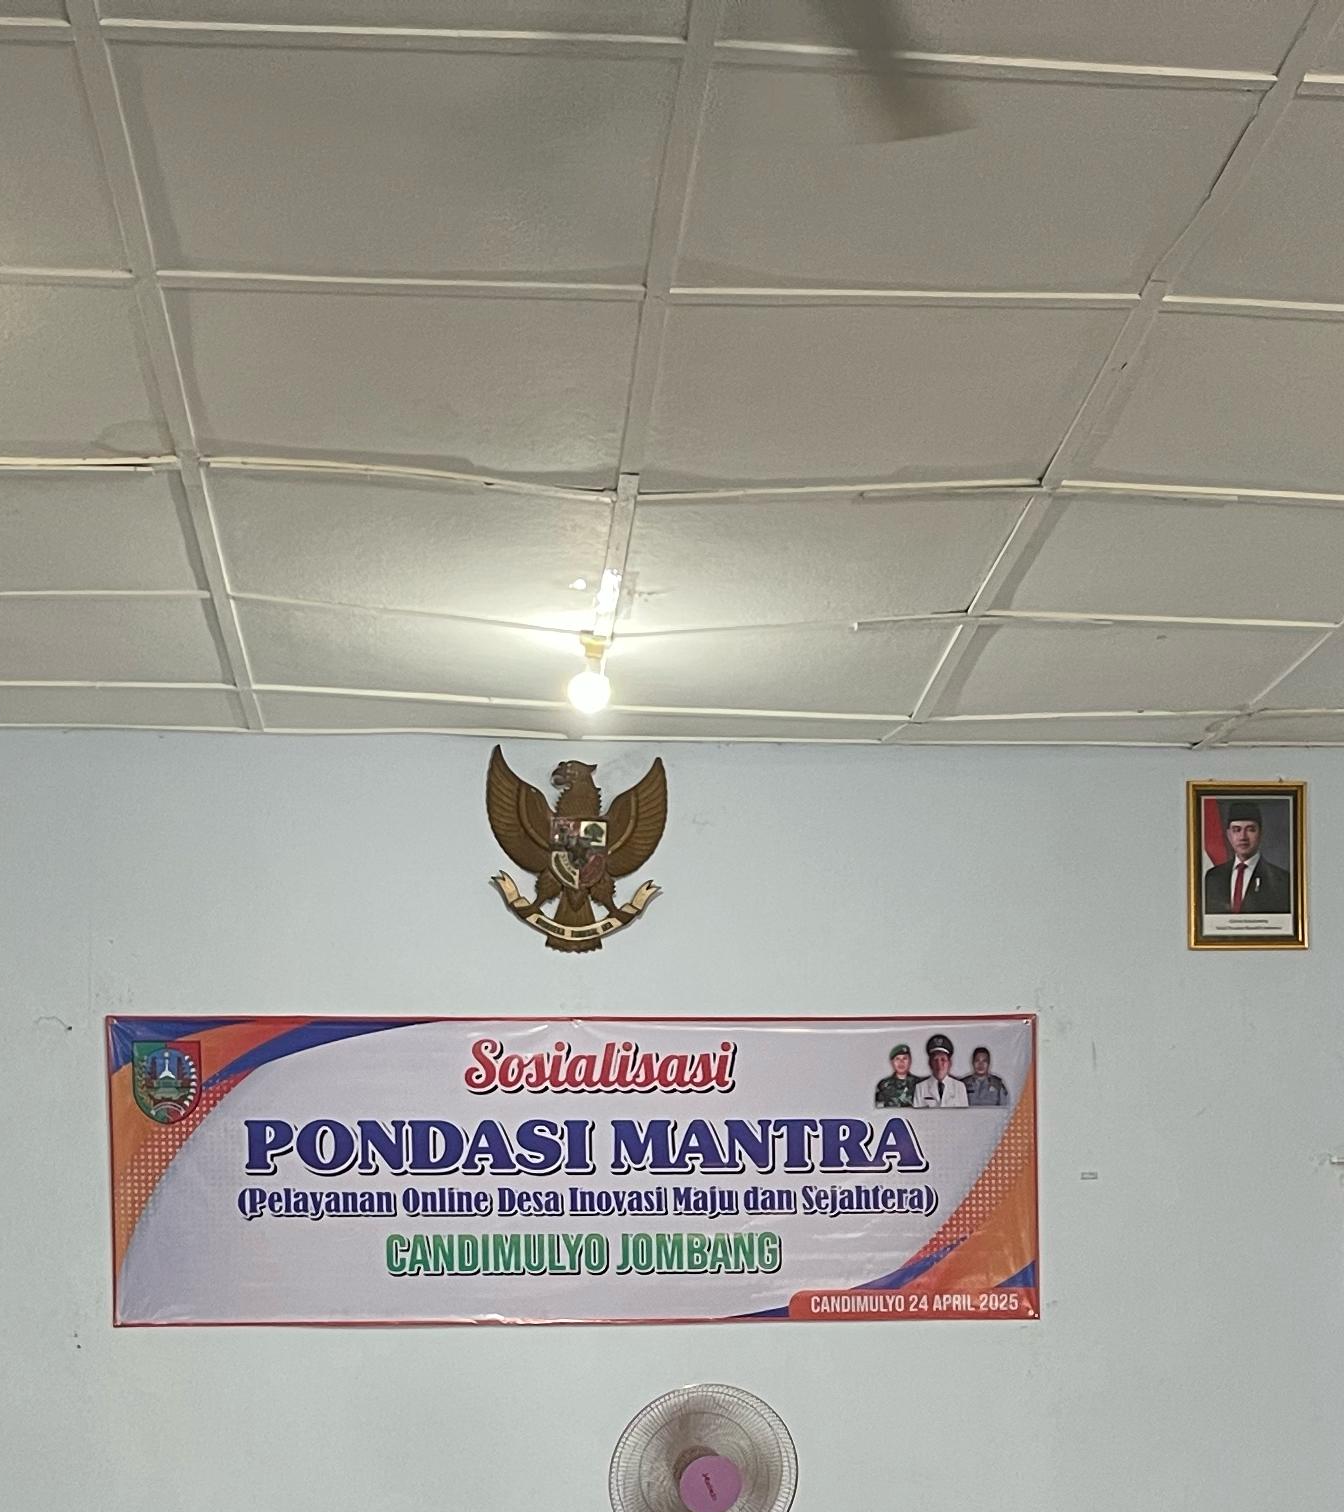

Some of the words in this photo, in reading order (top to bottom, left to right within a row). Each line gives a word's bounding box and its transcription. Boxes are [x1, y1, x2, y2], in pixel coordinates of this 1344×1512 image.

[464, 1038, 736, 1093] Sosialisasi
[243, 1118, 594, 1175] PONDASI
[610, 1117, 929, 1174] MANTRA
[238, 1186, 396, 1220] (Pelayanan
[402, 1187, 492, 1216] Online
[497, 1187, 563, 1215] Desa
[568, 1186, 667, 1215] Inovasi
[672, 1186, 738, 1217] Maju
[743, 1185, 796, 1214] dan
[801, 1184, 938, 1216] Sejahtera)
[385, 1231, 609, 1275] CANDIMULYO
[614, 1230, 782, 1273] JOMBANG
[810, 1295, 905, 1314] CANDIMULYO
[908, 1295, 928, 1312] 24
[932, 1294, 975, 1312] APRIL
[979, 1293, 1019, 1311] 2025
